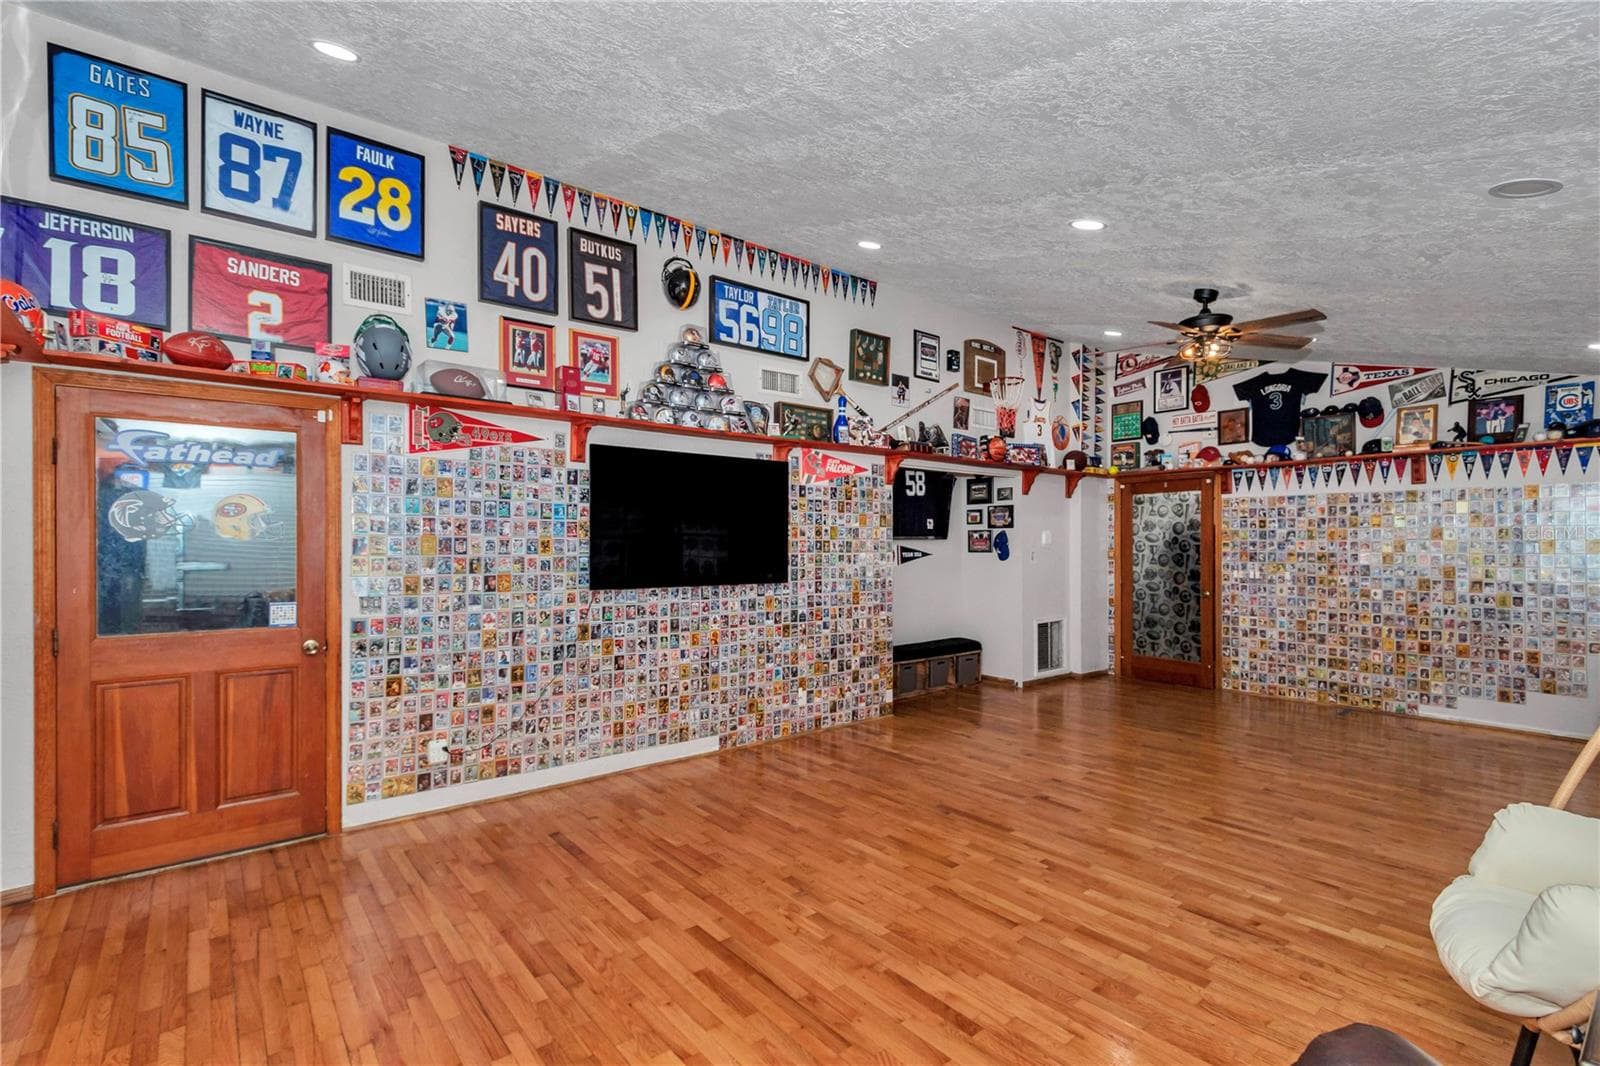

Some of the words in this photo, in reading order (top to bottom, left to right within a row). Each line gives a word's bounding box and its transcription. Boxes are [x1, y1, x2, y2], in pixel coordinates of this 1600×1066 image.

[89, 63, 151, 98] GATES
[68, 93, 174, 188] 85
[233, 110, 284, 141] WAYNE
[218, 132, 303, 212] 87
[356, 144, 395, 170] FAULK
[338, 166, 412, 232] 28
[38, 211, 135, 243] JEFFERSON
[495, 213, 541, 239] SAYERS
[580, 237, 622, 262] BUTKUS
[43, 237, 136, 317] 18
[227, 257, 301, 288] SANDERS
[493, 241, 547, 303] 40
[584, 262, 623, 323] 51
[724, 284, 754, 304] TAYLOR
[767, 295, 801, 315] TAYLOR
[247, 289, 284, 342] 2
[719, 301, 760, 349] 56
[105, 327, 144, 343] FOOTBALL
[761, 308, 803, 356] 98
[1363, 368, 1410, 380] TEXAS
[1484, 373, 1550, 385] CHICAGO
[1269, 391, 1283, 410] 3
[107, 429, 284, 467] Fathead
[826, 463, 855, 474] FALCONS
[905, 470, 926, 496] 58
